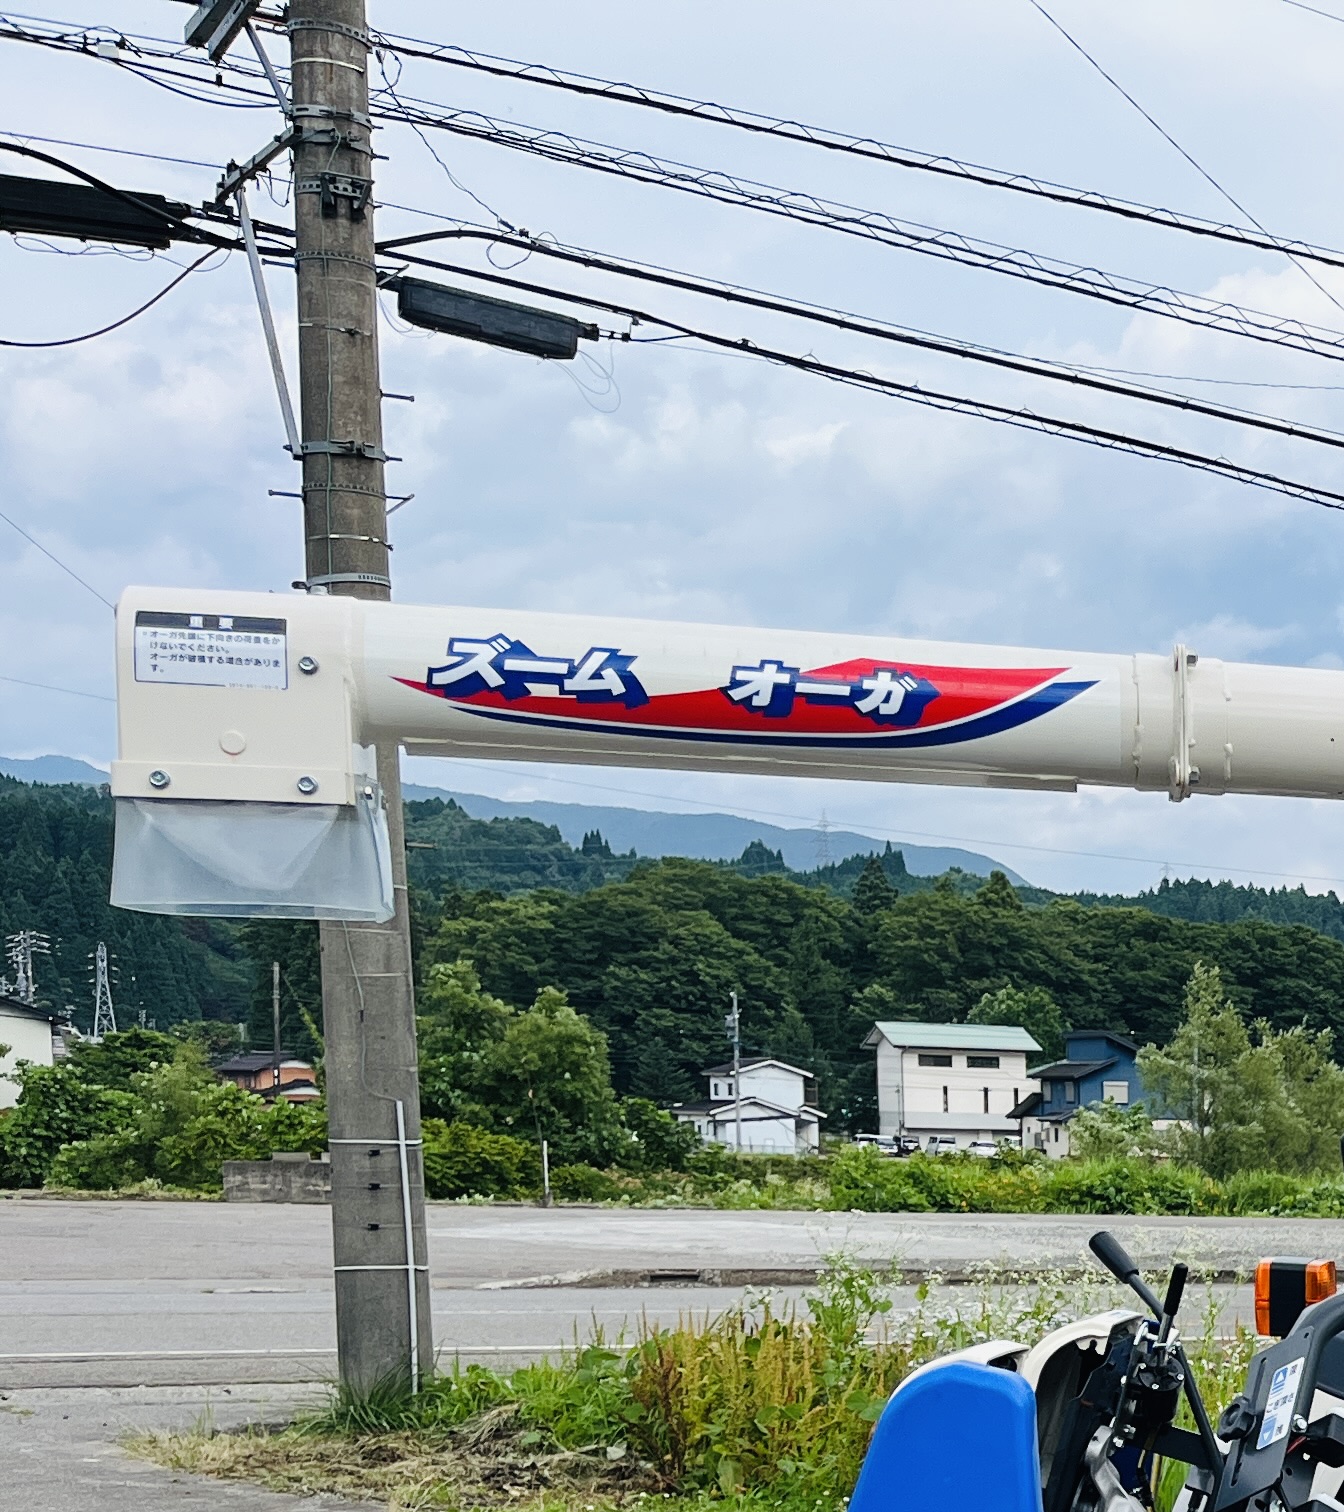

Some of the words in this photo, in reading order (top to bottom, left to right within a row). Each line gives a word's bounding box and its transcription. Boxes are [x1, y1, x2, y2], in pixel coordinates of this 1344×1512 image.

[429, 635, 635, 700] ズーム
[729, 662, 922, 718] オーガ
